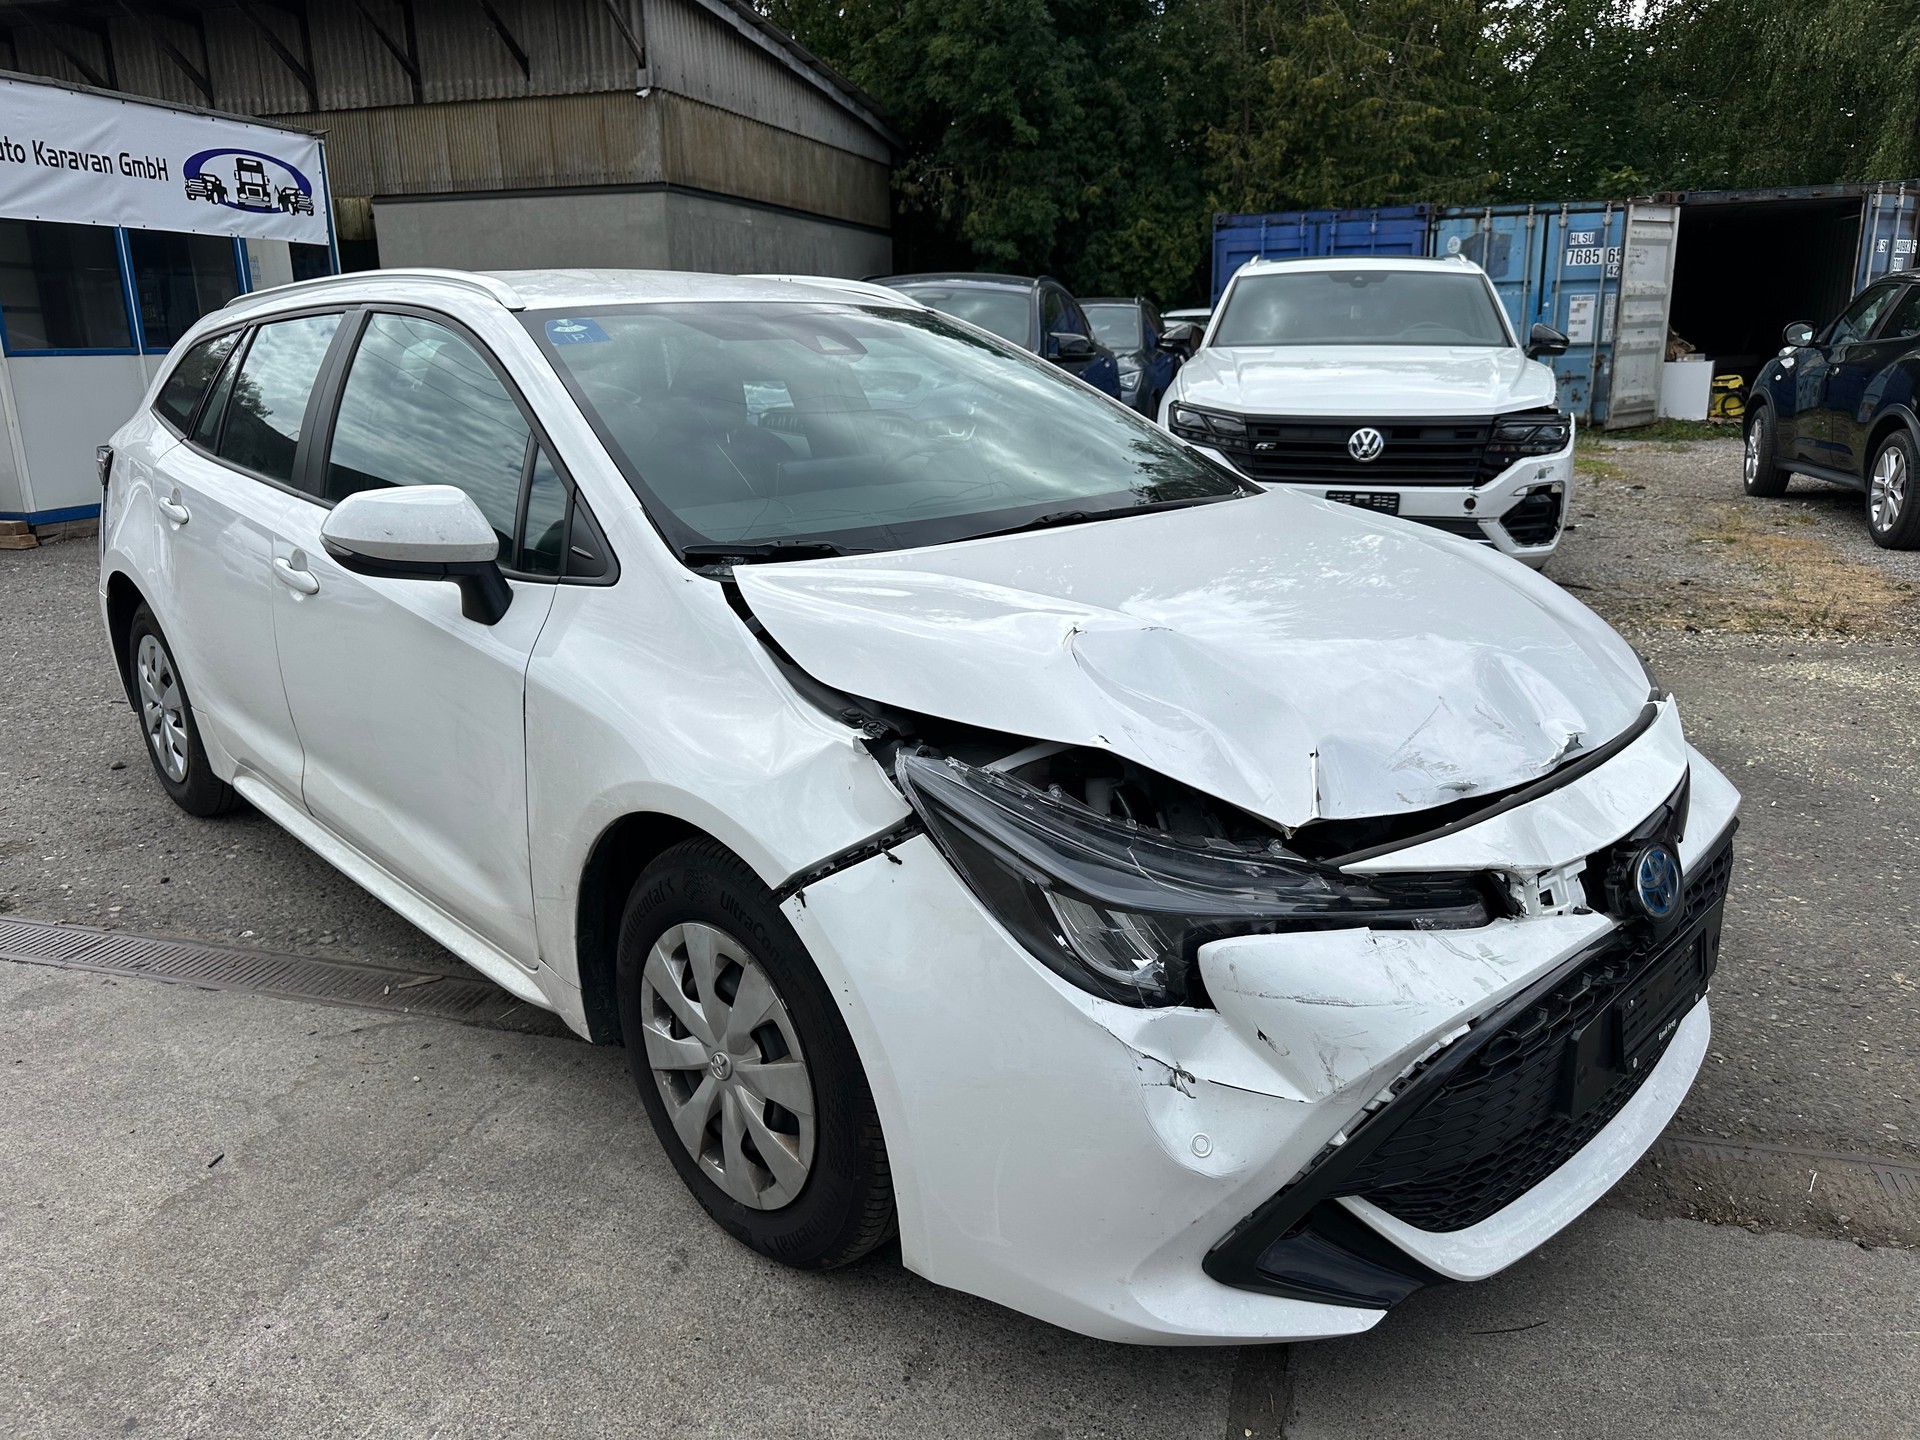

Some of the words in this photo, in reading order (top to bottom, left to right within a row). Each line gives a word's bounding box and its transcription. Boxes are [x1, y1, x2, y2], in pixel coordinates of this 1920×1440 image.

[32, 139, 113, 175] Karavan
[119, 152, 169, 182] GmbH
[1570, 234, 1594, 244] HLSU
[620, 880, 666, 966] Continental
[718, 891, 806, 998] UltraContact
